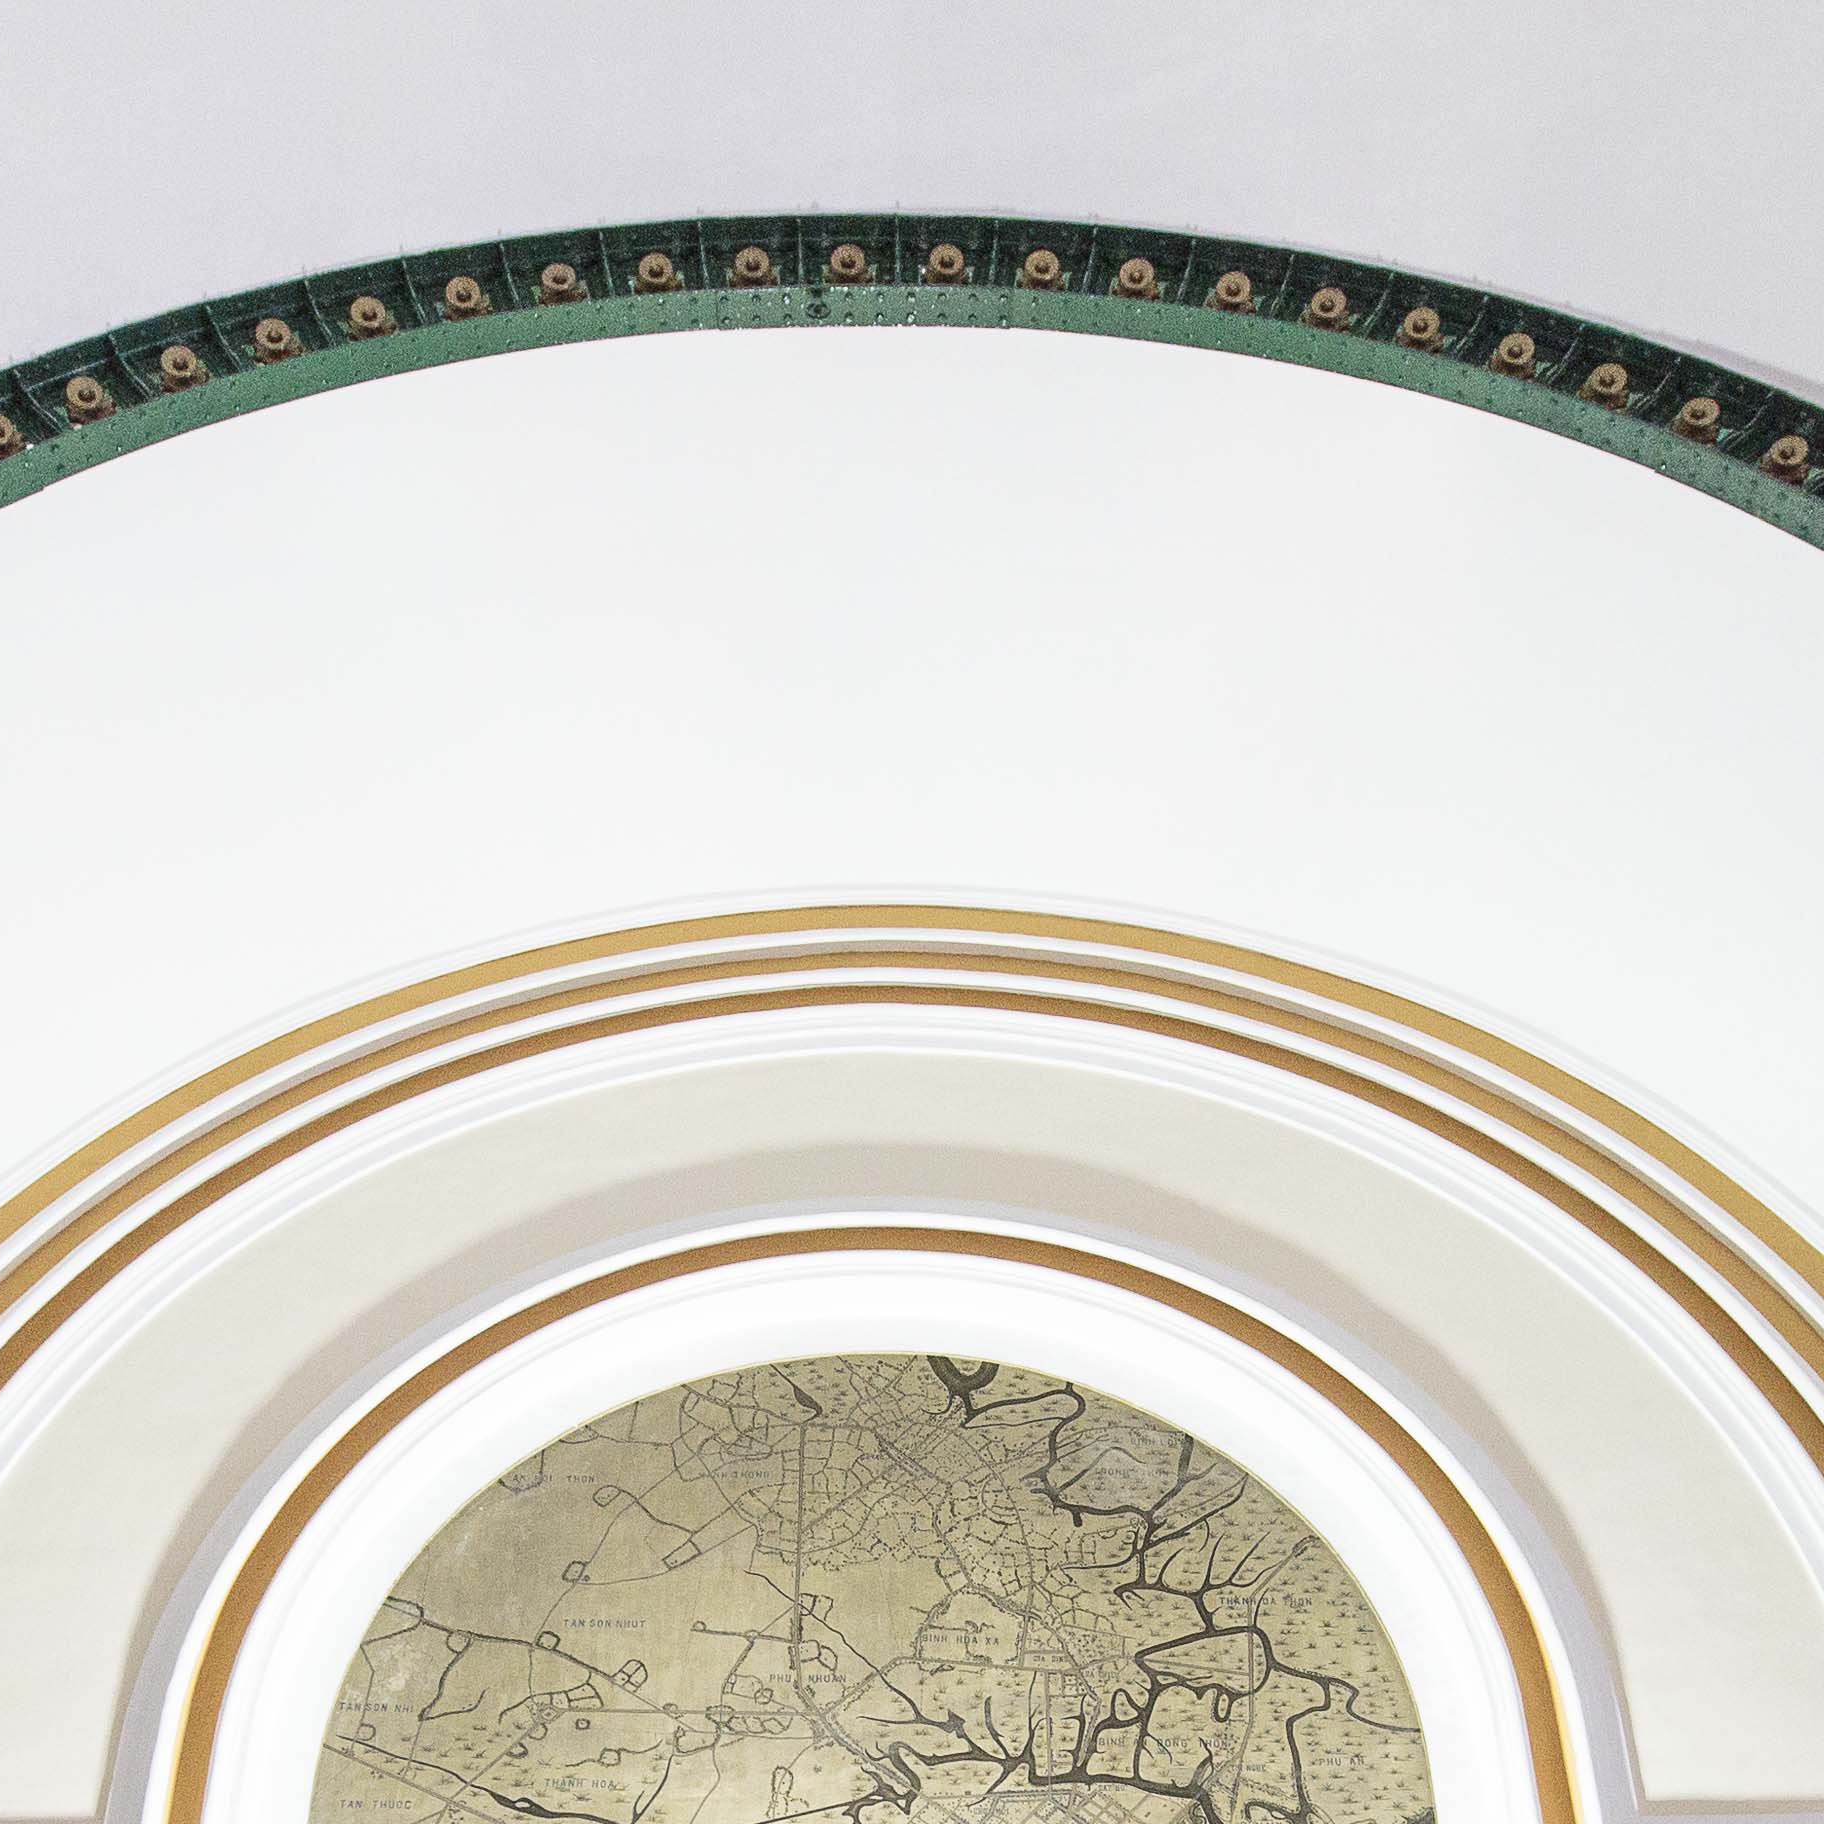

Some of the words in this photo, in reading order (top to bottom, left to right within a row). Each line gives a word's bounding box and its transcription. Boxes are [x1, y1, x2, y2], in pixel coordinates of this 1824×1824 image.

[563, 1619, 586, 1628] TAN
[589, 1619, 612, 1628] SON
[616, 1619, 646, 1629] NHUT
[769, 1673, 791, 1683] PHU
[339, 1702, 364, 1713] TAN
[367, 1702, 388, 1713] SON
[544, 1778, 586, 1788] THANH
[340, 1799, 363, 1810] TAN
